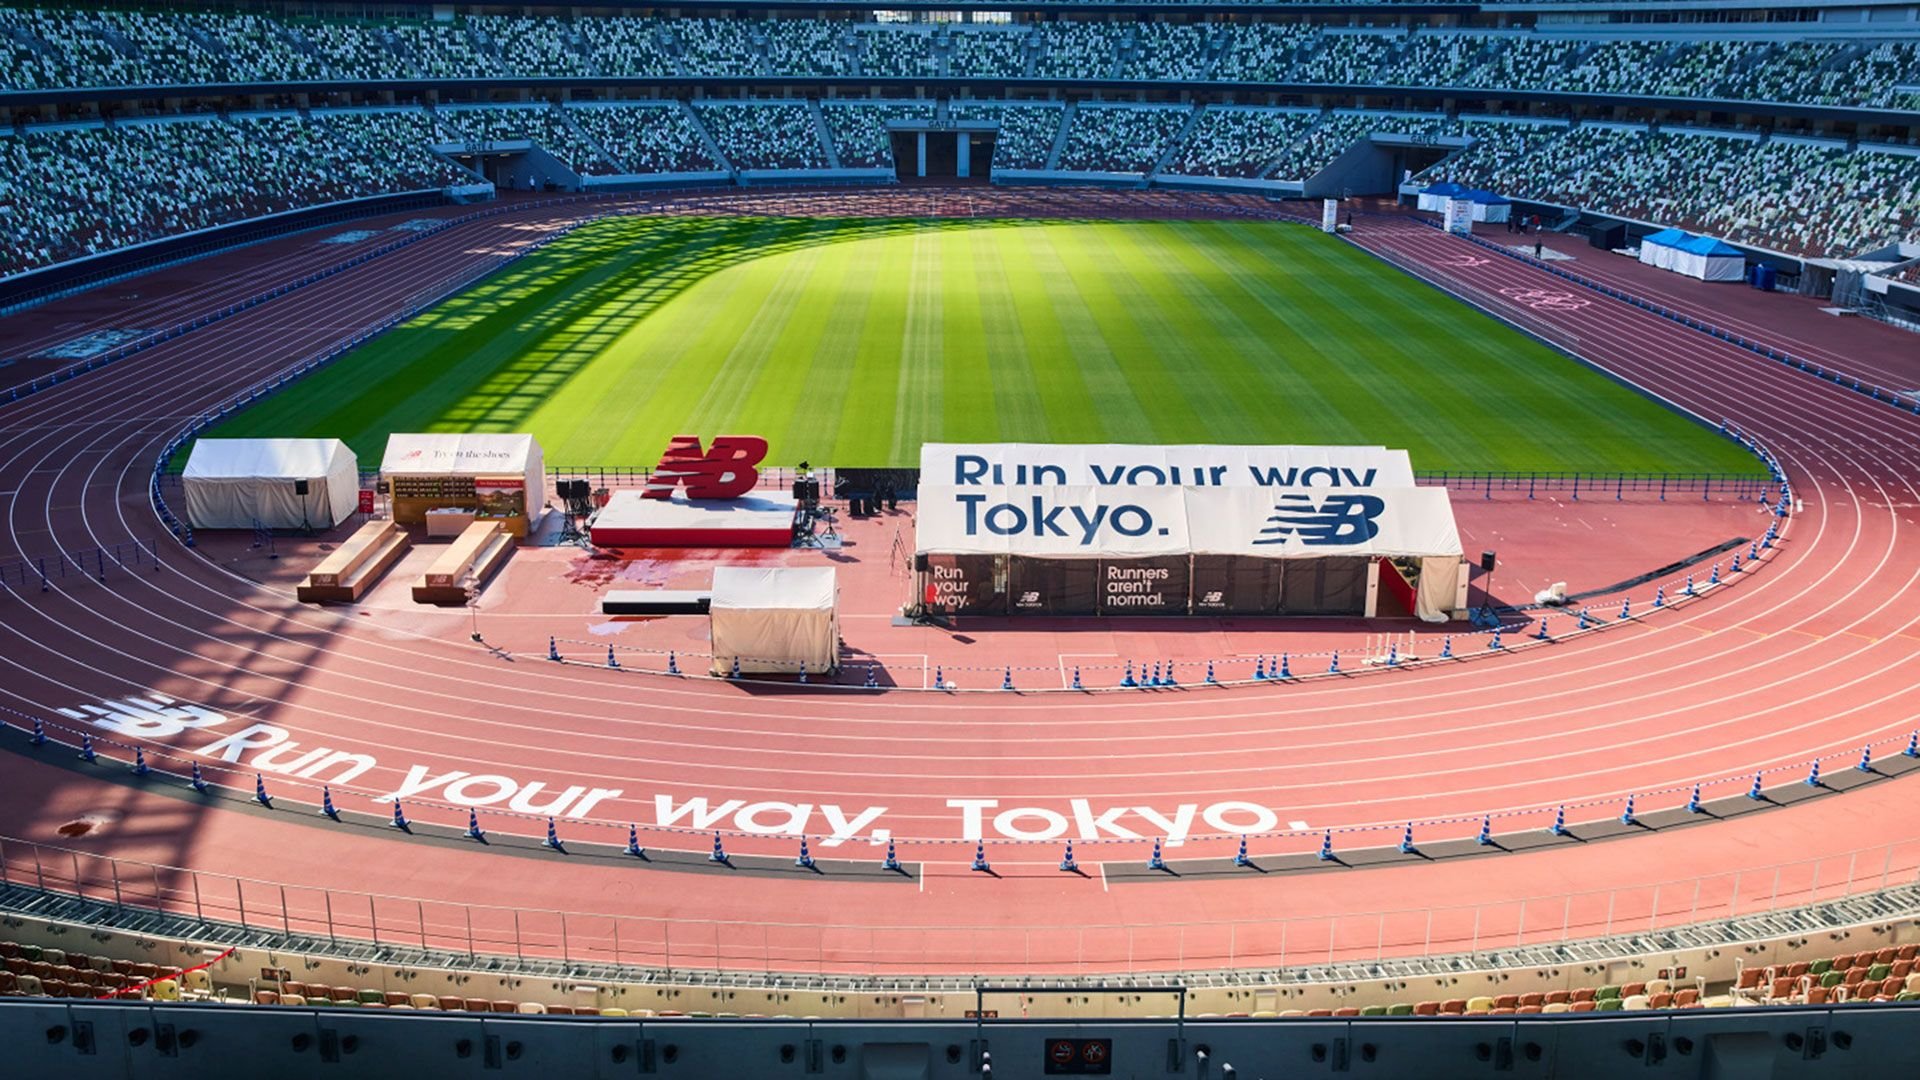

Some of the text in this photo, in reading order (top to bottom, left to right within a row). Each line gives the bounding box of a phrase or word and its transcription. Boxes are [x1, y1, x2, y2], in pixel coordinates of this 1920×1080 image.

[640, 434, 768, 499] NB
[955, 494, 1169, 545] Tokyo.
[1252, 494, 1385, 545] NB
[933, 565, 963, 579] Run
[1107, 566, 1169, 580] Runners
[933, 581, 969, 595] your
[1107, 579, 1152, 593] aren't
[933, 594, 970, 609] way.
[1107, 592, 1165, 606] normal.
[195, 723, 376, 784] Run
[372, 765, 623, 819] your
[946, 797, 1310, 848] Tokyo.
